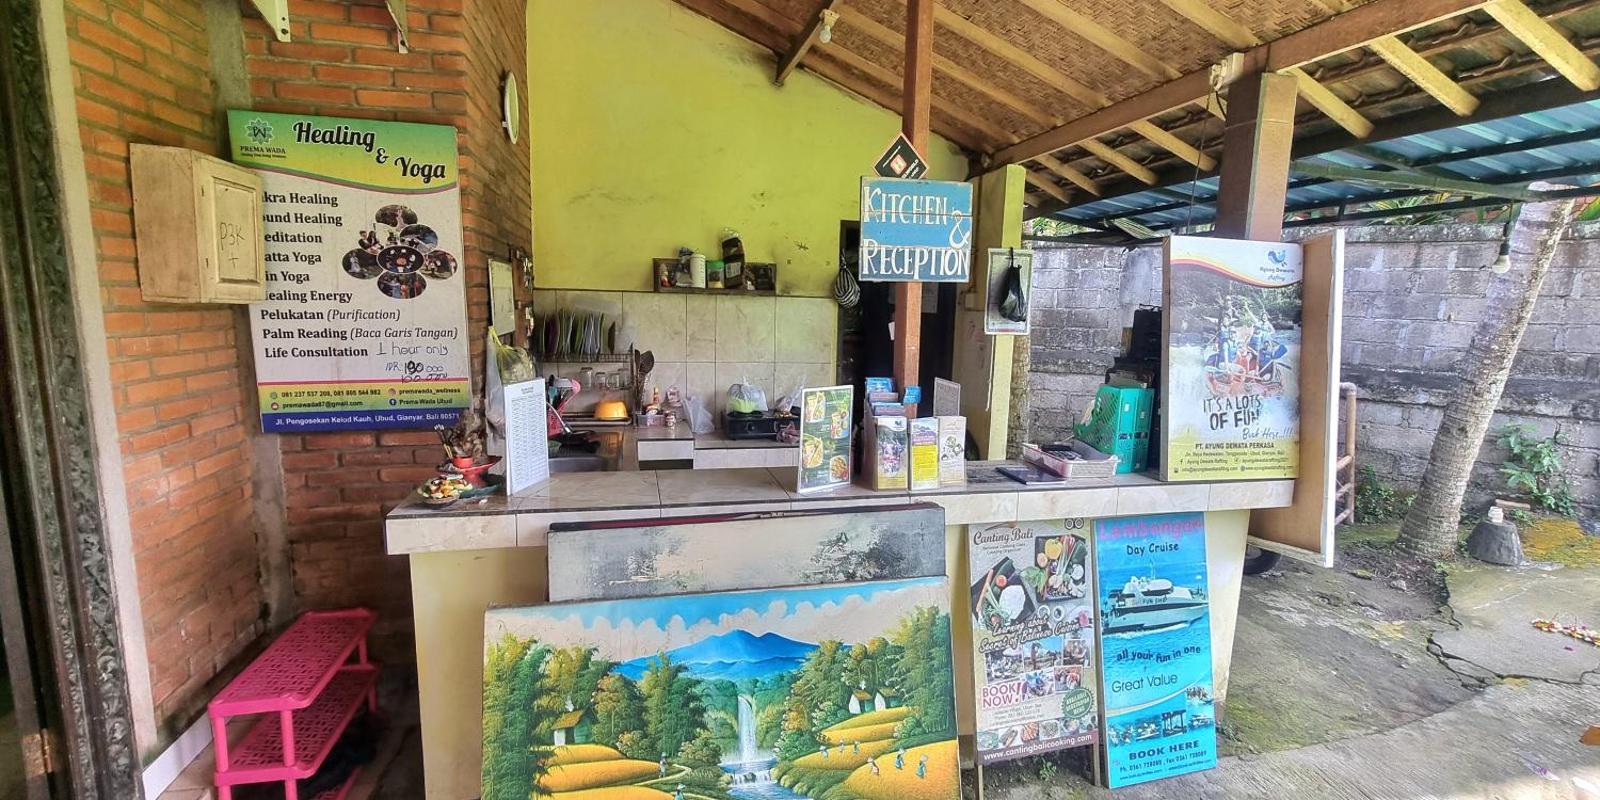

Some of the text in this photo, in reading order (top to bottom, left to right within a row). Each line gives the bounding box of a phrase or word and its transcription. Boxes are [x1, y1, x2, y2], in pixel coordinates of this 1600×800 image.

[292, 121, 376, 153] Healing
[240, 145, 264, 153] PREMA
[376, 147, 389, 164] &
[394, 157, 446, 184] Yoga
[263, 191, 338, 208] kra Healing
[263, 212, 343, 226] und Healing
[949, 206, 970, 249] &
[264, 231, 323, 243] editation
[264, 252, 322, 265] atta Yoga
[280, 271, 310, 284] Yoga
[266, 290, 353, 304] ealing Energy
[260, 309, 401, 323] Pelukatan (Purification)
[262, 327, 458, 341] Palm Reading (Baca Garis Tangan)
[265, 346, 368, 358] Life Consultation
[391, 341, 422, 355] hour
[426, 342, 448, 356] only
[1203, 394, 1262, 413] IT'S A LOTS
[286, 416, 330, 425] Pengosekan
[374, 414, 396, 422] Ubud,
[1210, 413, 1229, 431] OF
[973, 527, 1034, 545] Canting Bali
[1126, 542, 1179, 557] Day Cruise
[1116, 646, 1201, 663] all your fun in one
[1111, 674, 1178, 693] Great Value
[983, 734, 1092, 760] www.cantingbalicooking.com
[1129, 740, 1200, 761] BOOK HERE
